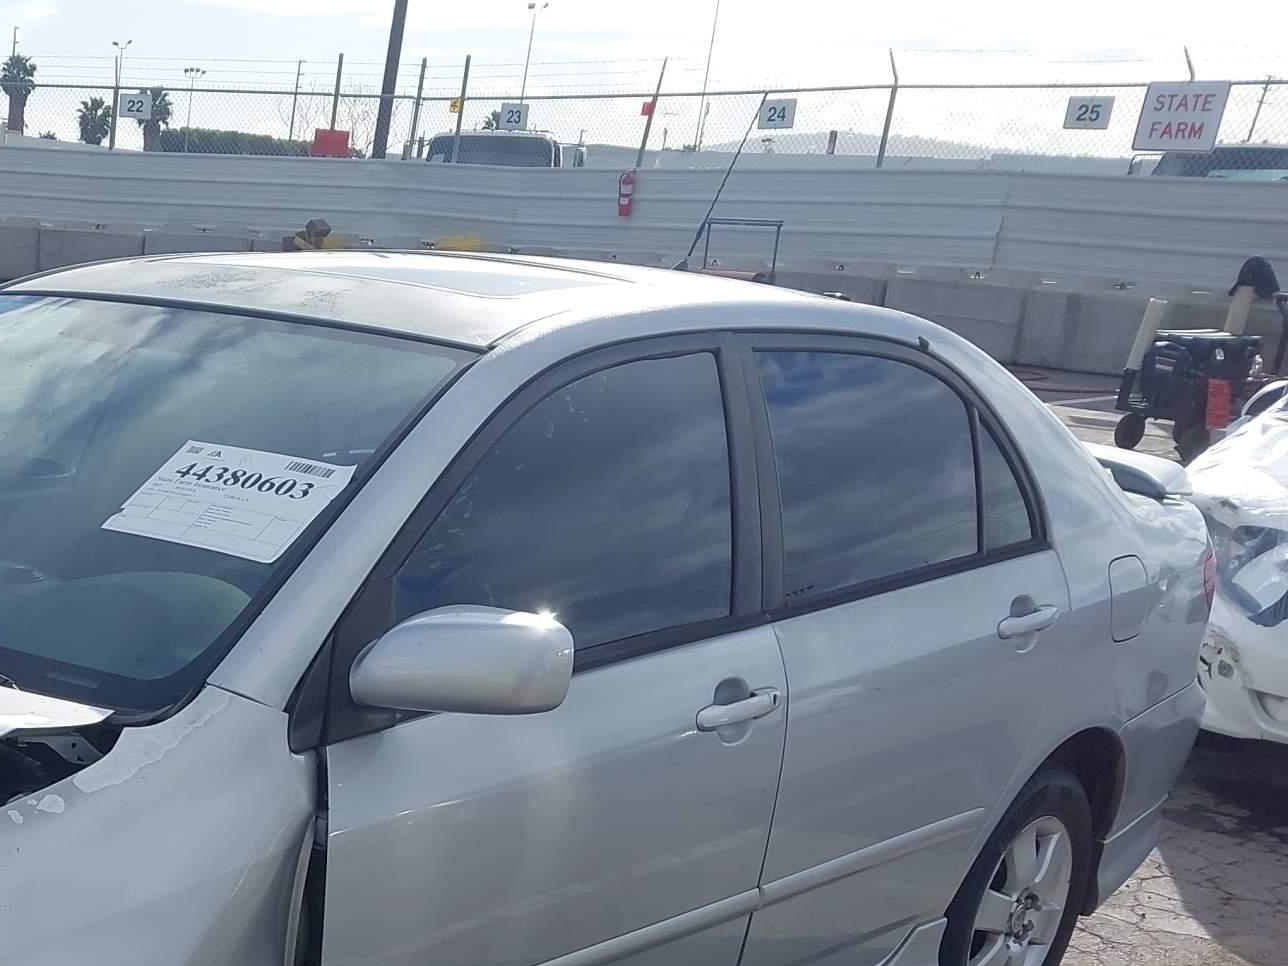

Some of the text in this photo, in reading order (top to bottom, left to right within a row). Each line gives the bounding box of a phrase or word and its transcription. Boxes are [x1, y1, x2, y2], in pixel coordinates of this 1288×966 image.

[127, 99, 144, 112] 22
[1153, 93, 1216, 112] STATE
[506, 109, 521, 124] 23
[766, 106, 786, 122] 24
[1076, 103, 1101, 122] 25
[1148, 121, 1205, 140] FARM
[174, 478, 193, 487] Farm
[175, 462, 315, 500] 44380603
